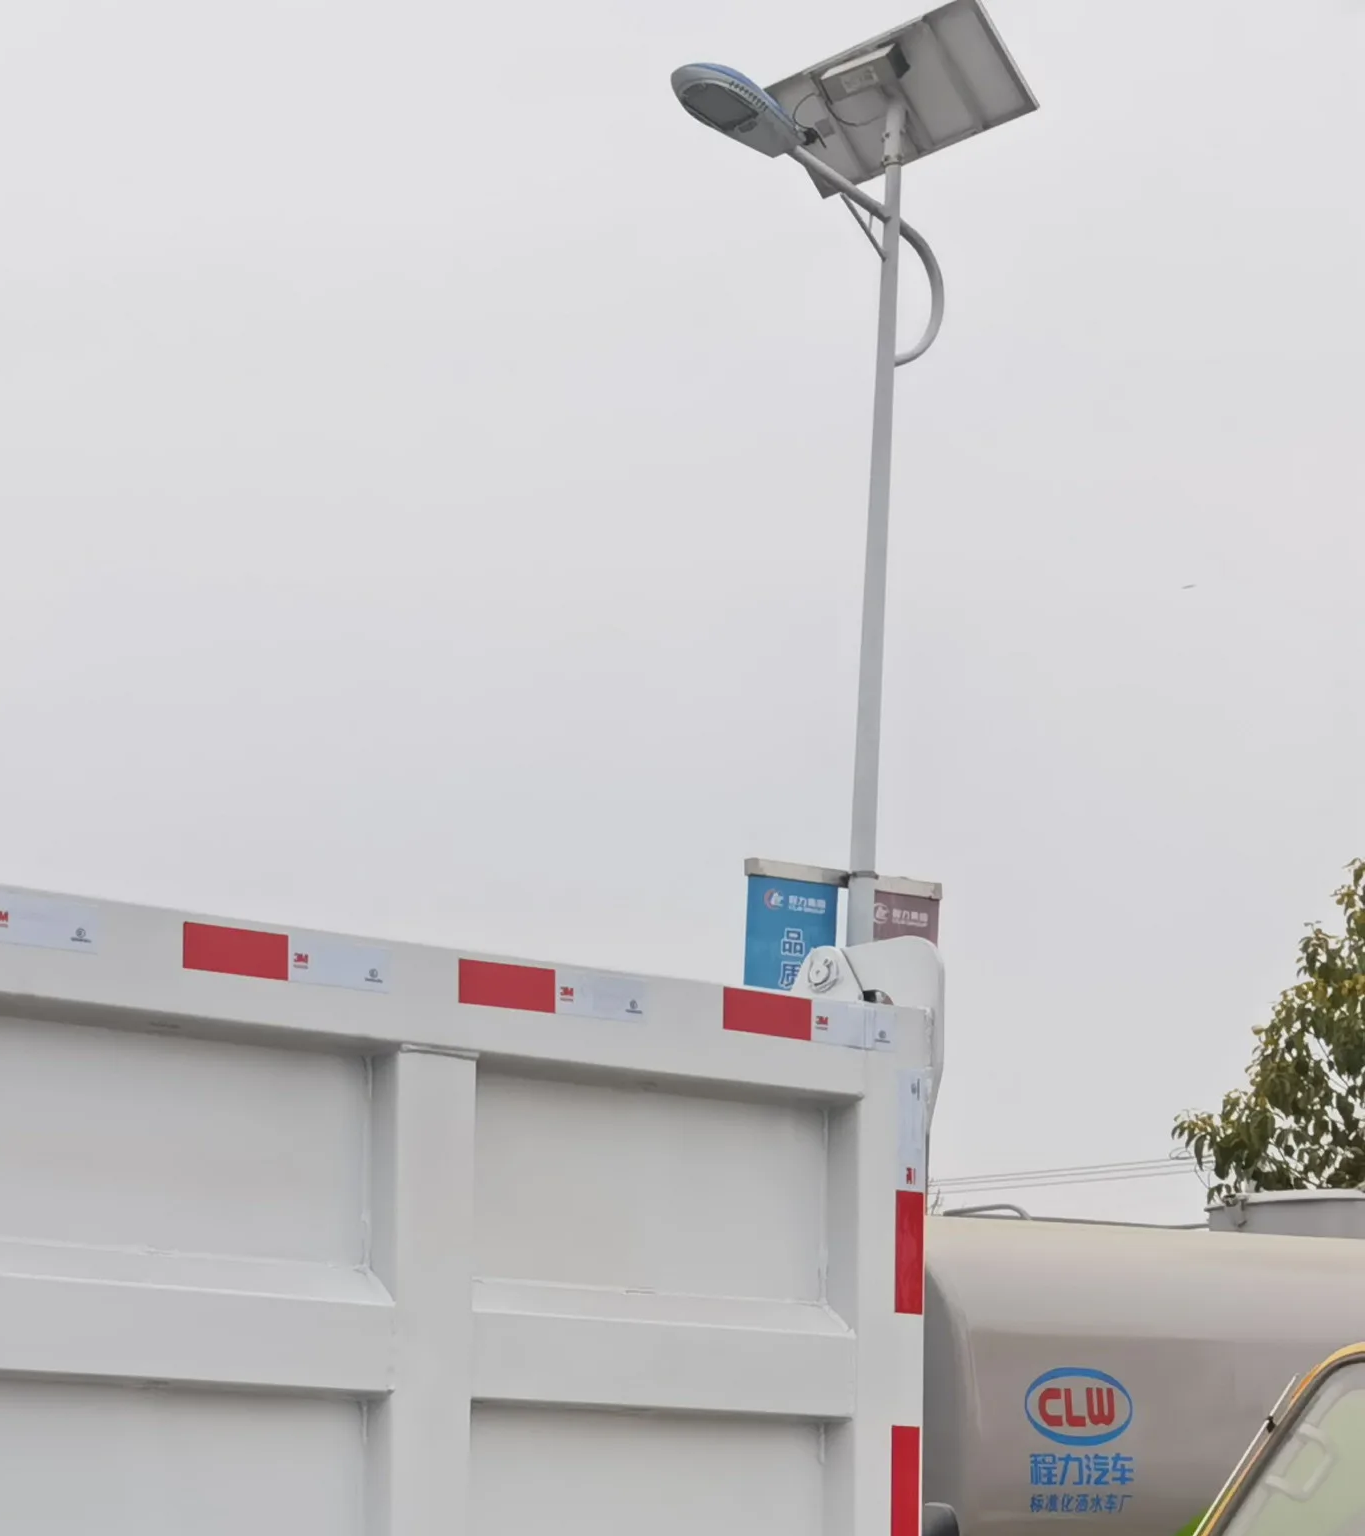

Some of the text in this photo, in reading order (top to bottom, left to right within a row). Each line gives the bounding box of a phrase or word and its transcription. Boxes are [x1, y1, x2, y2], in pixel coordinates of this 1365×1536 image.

[294, 954, 310, 964] 3M
[1037, 1386, 1116, 1427] CLW
[1029, 1452, 1135, 1486] 程力汽车
